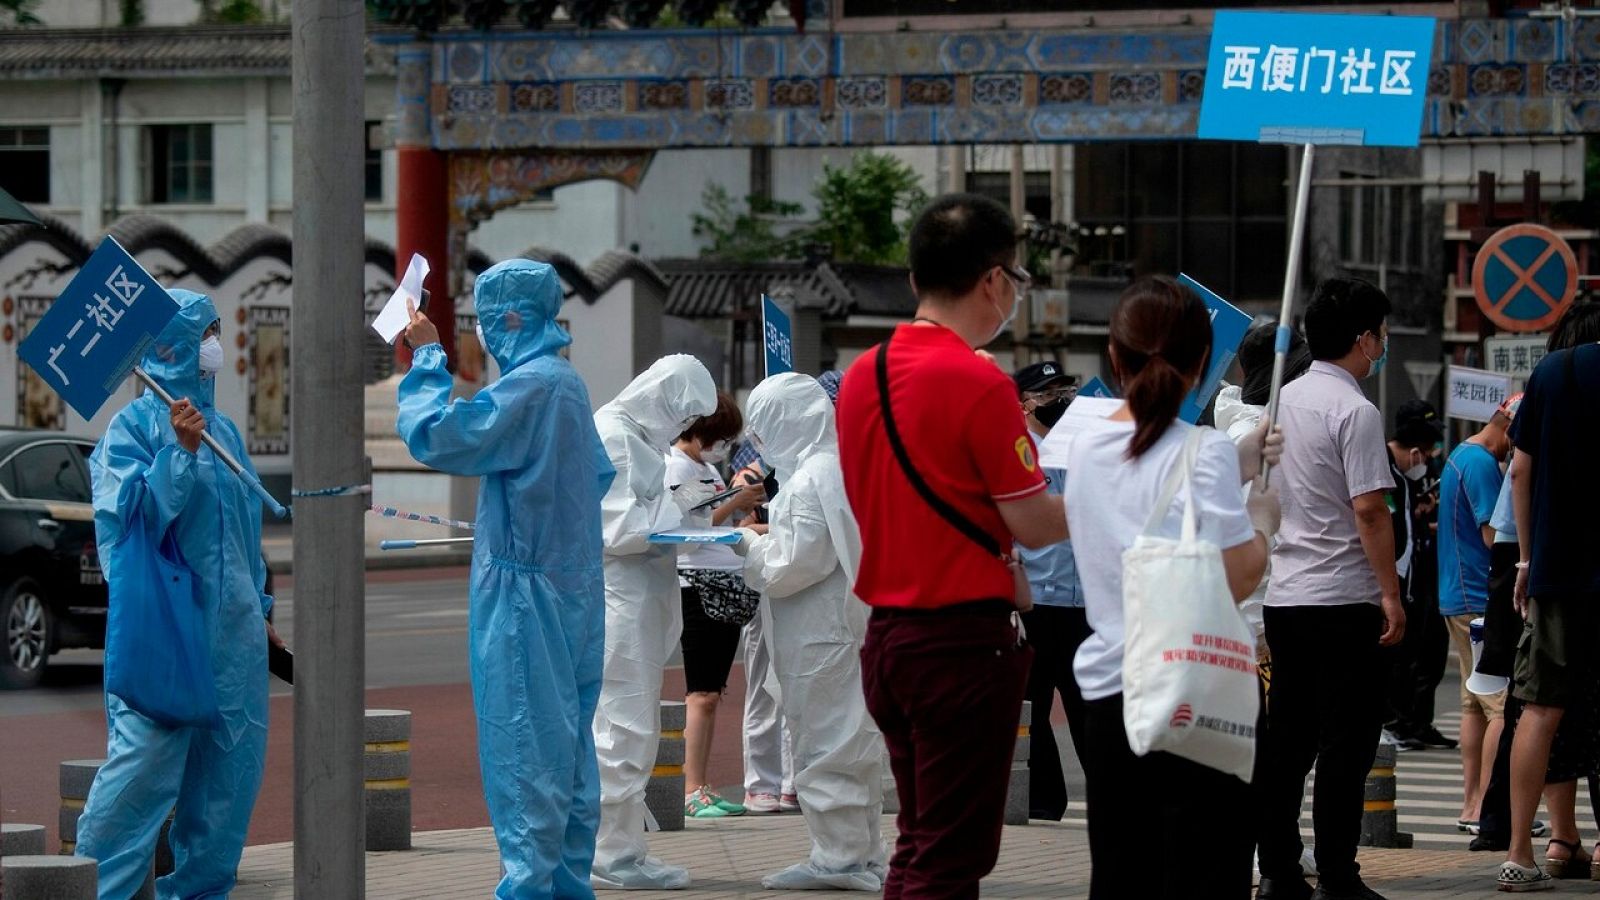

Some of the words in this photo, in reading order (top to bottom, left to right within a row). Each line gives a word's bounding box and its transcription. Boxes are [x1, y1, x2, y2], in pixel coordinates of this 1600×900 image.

[1222, 44, 1416, 96] 西便门社区
[46, 264, 146, 386] 广二社区
[1453, 381, 1505, 405] 菜园街
